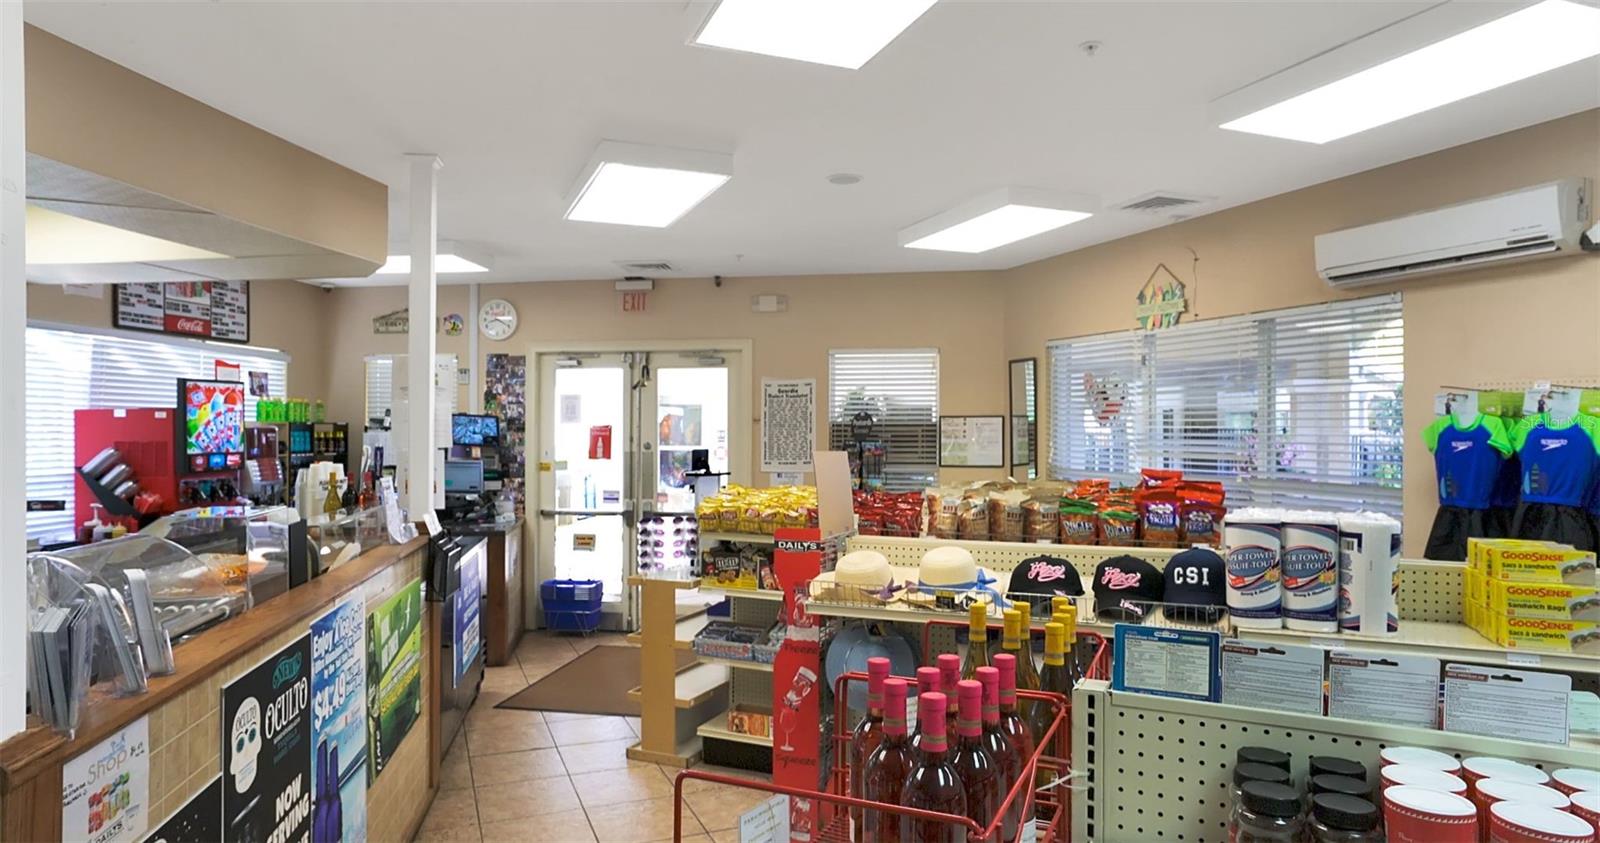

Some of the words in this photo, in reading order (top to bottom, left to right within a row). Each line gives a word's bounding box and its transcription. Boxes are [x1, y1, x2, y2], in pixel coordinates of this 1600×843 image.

[623, 292, 648, 311] EXIT
[1173, 566, 1210, 586] CSI
[1508, 602, 1545, 610] Sandwich
[1547, 604, 1566, 612] Bags
[1531, 631, 1566, 640] sandwich
[265, 676, 308, 739] OCULTO
[87, 748, 128, 786] Shop
[275, 772, 302, 824] NOW
